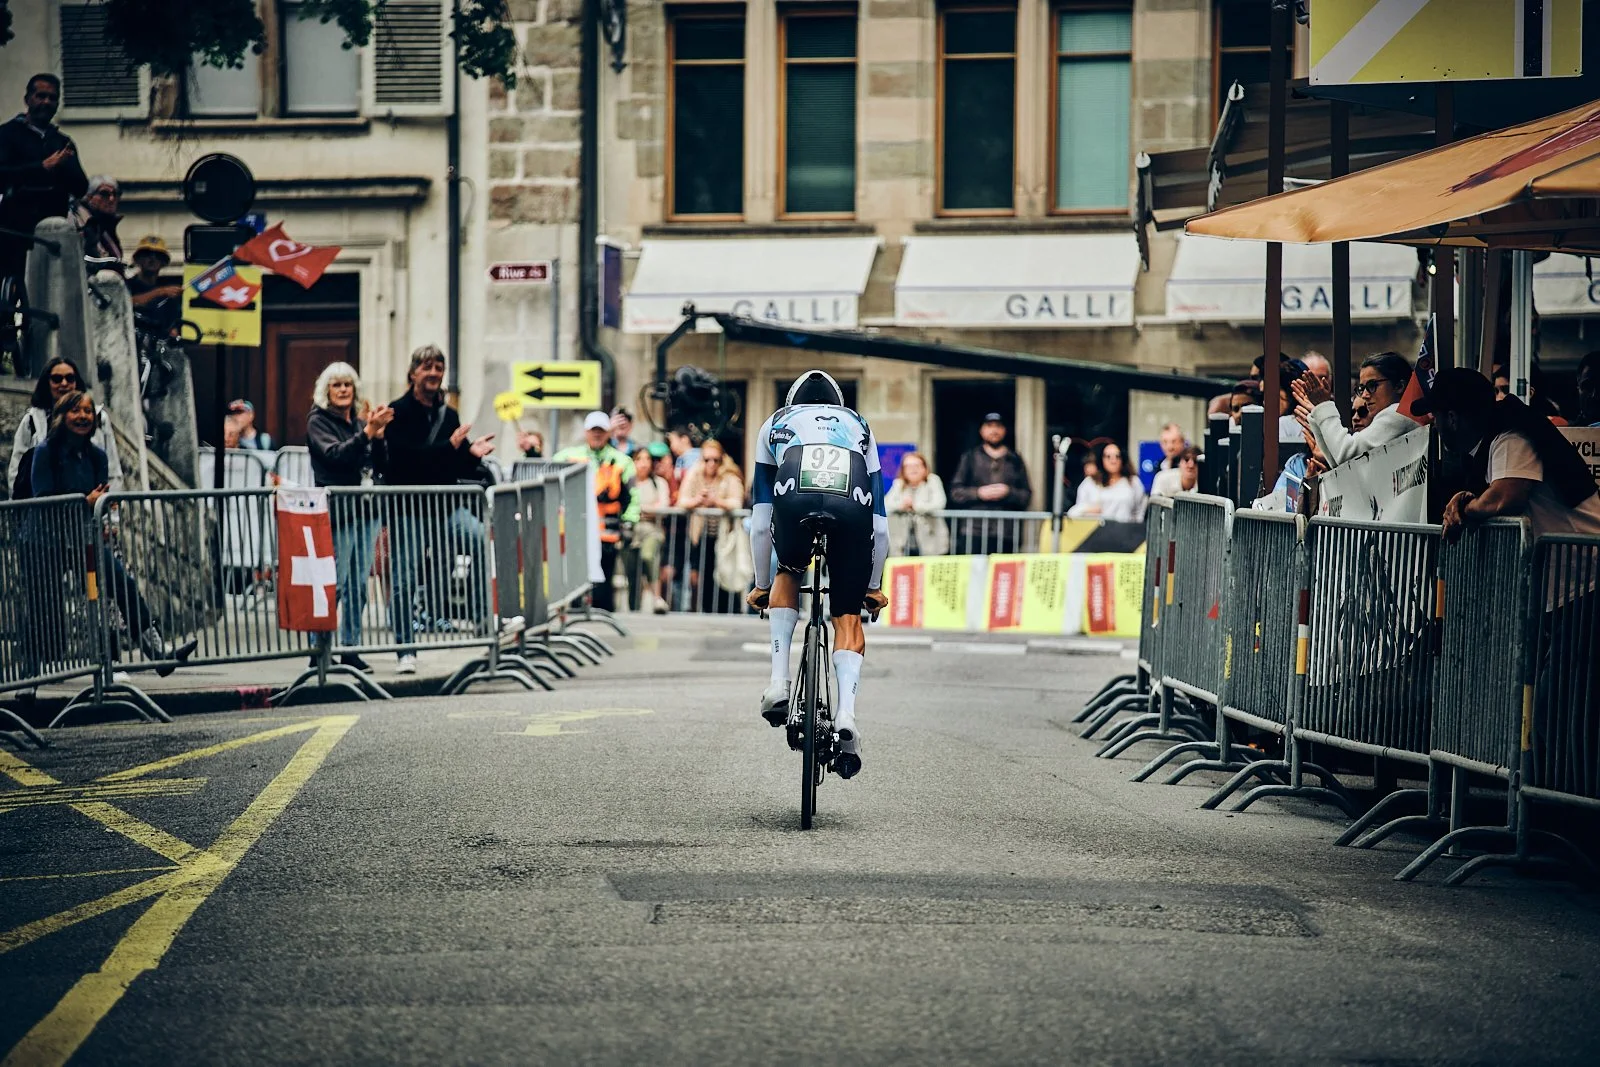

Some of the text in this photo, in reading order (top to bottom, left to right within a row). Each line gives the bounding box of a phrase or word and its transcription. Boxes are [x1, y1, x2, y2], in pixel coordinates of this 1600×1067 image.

[1005, 293, 1116, 319] GALLI
[1281, 284, 1392, 311] GALI
[732, 299, 841, 323] GALLI
[811, 447, 840, 471] 92
